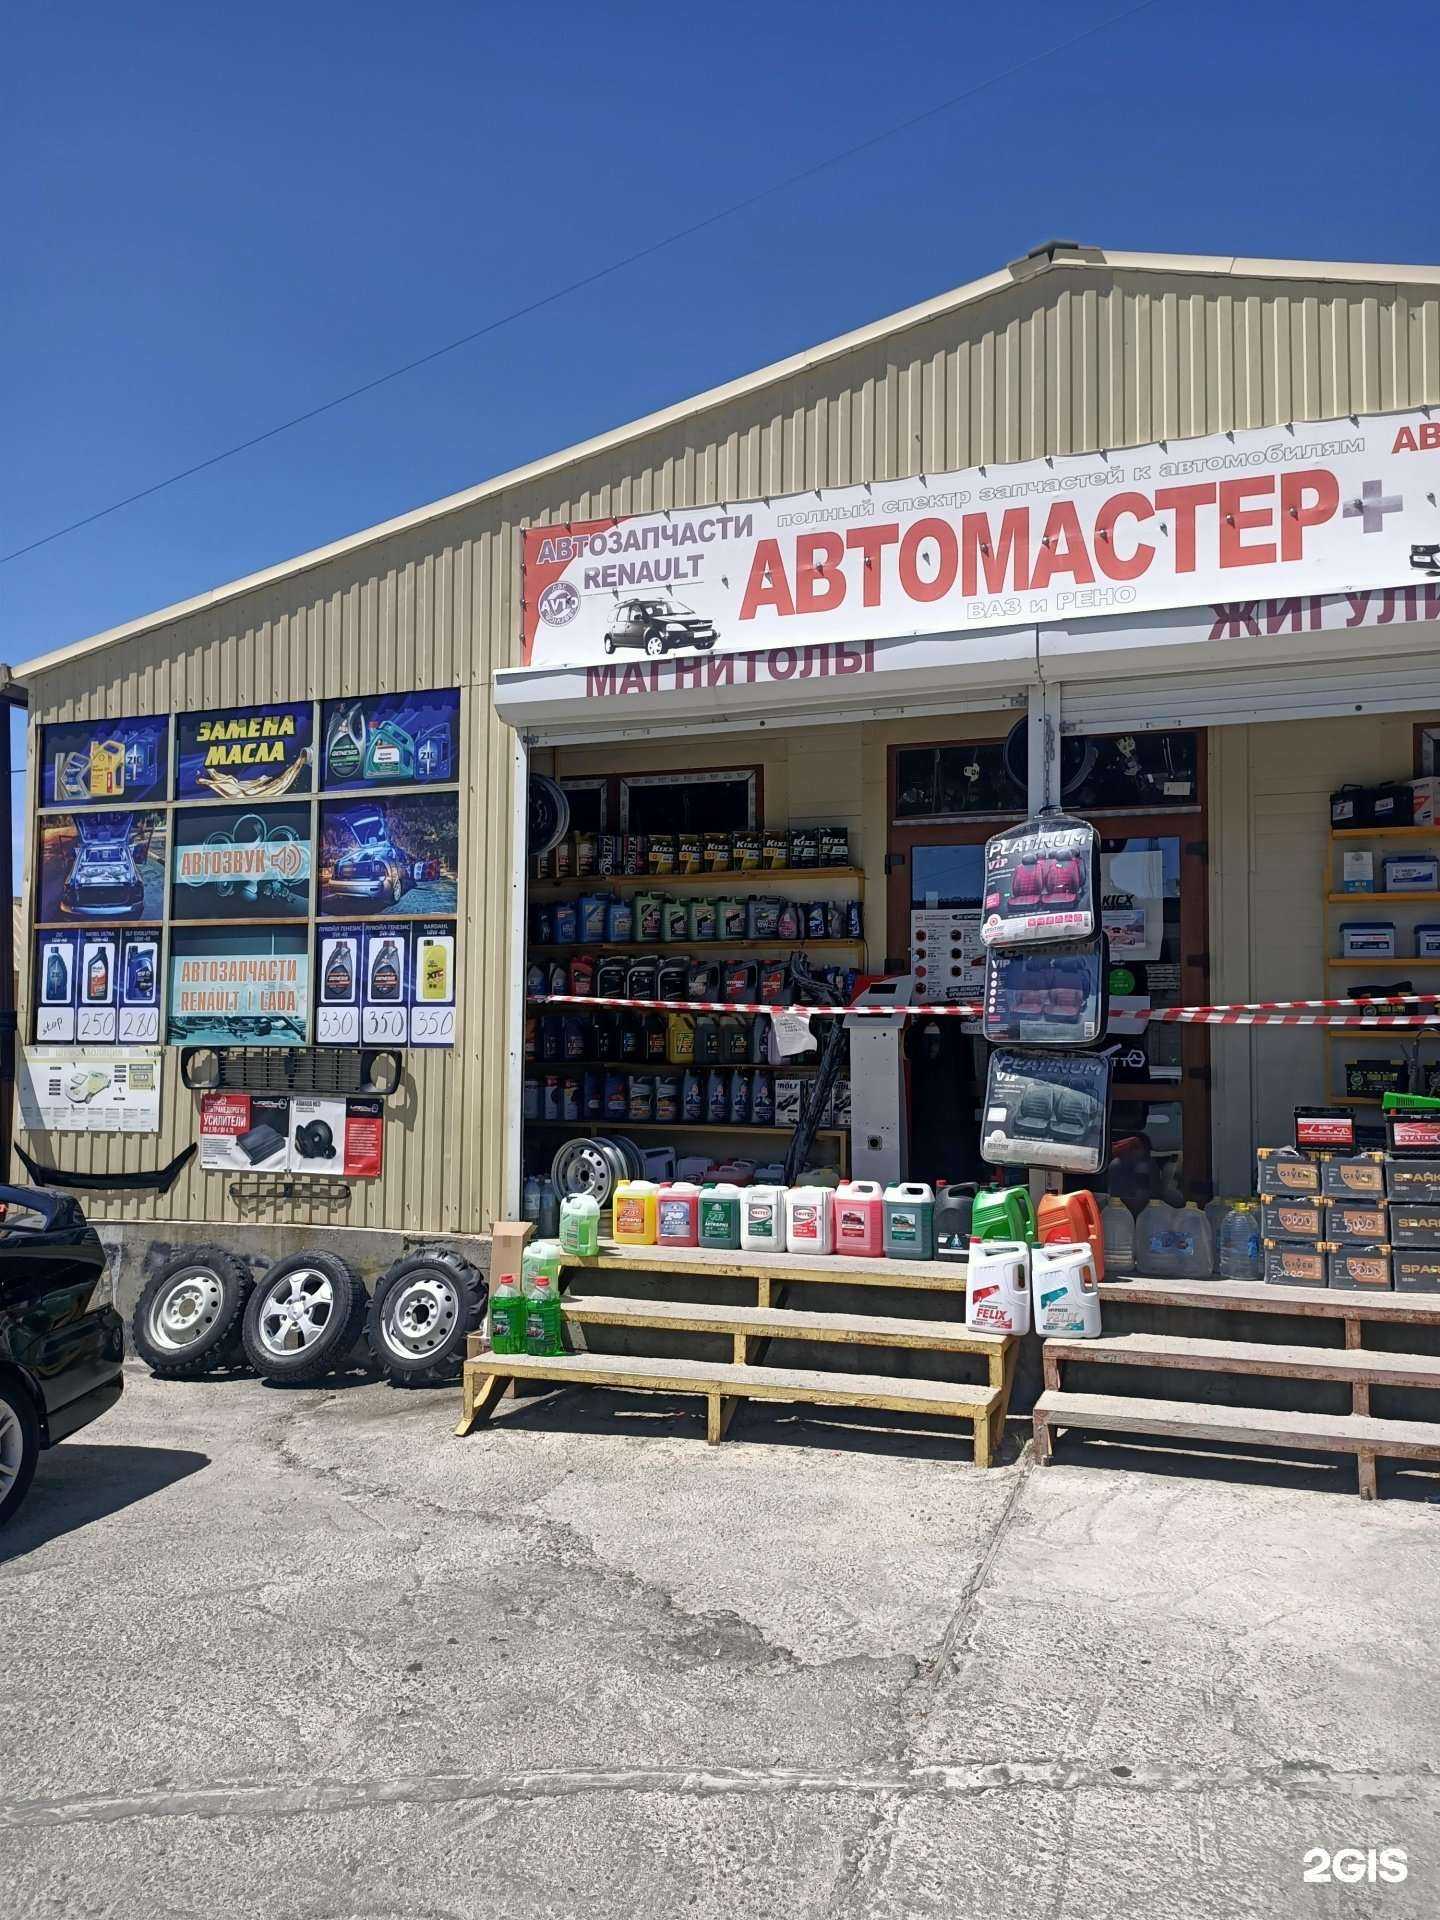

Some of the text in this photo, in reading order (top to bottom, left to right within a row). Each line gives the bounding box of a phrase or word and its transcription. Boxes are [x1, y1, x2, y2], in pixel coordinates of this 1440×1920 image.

[777, 437, 1366, 528] полный спектр запчастей к автомобилям
[536, 513, 754, 565] АВТОЗАПЧАСТИ
[584, 553, 705, 590] RENAULT
[967, 586, 1137, 619] ВАЗ и РЕНО
[585, 639, 875, 697] МАГНИТОЛЫ
[196, 714, 295, 742] ЗАМЕНА
[204, 741, 285, 767] МАСЛА
[988, 832, 1086, 858] PLATINUM
[181, 850, 266, 876] АВТОЗВУК
[181, 959, 297, 983] АВТОЗАПЧАСТИ
[180, 990, 296, 1012] RENAULT LADA
[81, 1012, 115, 1036] 250
[319, 1012, 353, 1037] 330
[368, 1011, 404, 1037] 350
[999, 1055, 1101, 1076] PLATINUM
[1398, 1218, 1440, 1228] SPAR
[976, 1307, 1008, 1321] FELIX
